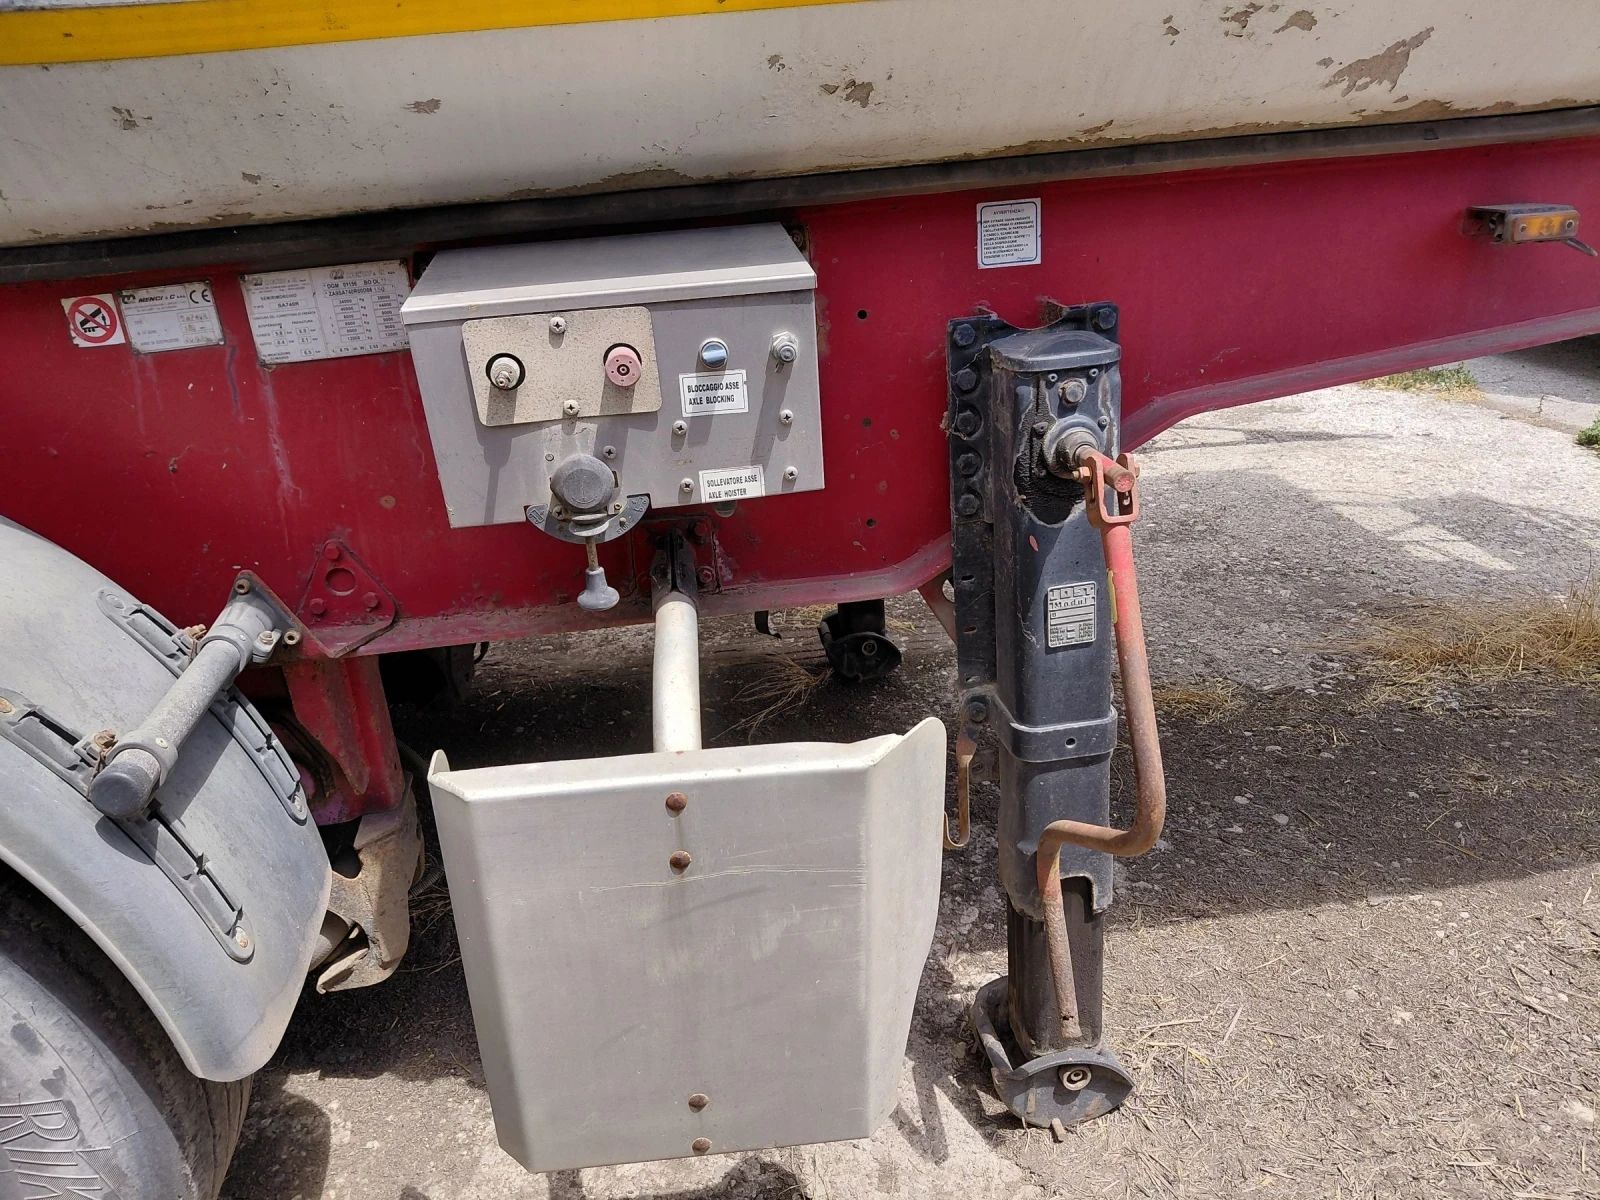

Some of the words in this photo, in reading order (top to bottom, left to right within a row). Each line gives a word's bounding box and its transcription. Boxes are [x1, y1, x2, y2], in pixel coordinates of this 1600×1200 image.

[138, 294, 163, 303] MENCI
[190, 289, 211, 304] CE
[687, 382, 724, 393] BLOCCAGGIO
[725, 381, 740, 390] ASSE
[689, 397, 703, 406] AXLE
[705, 394, 735, 405] BLOCKING
[707, 479, 743, 488] SOLLEVATORE
[744, 474, 758, 483] ASSE
[708, 490, 722, 500] AXLE
